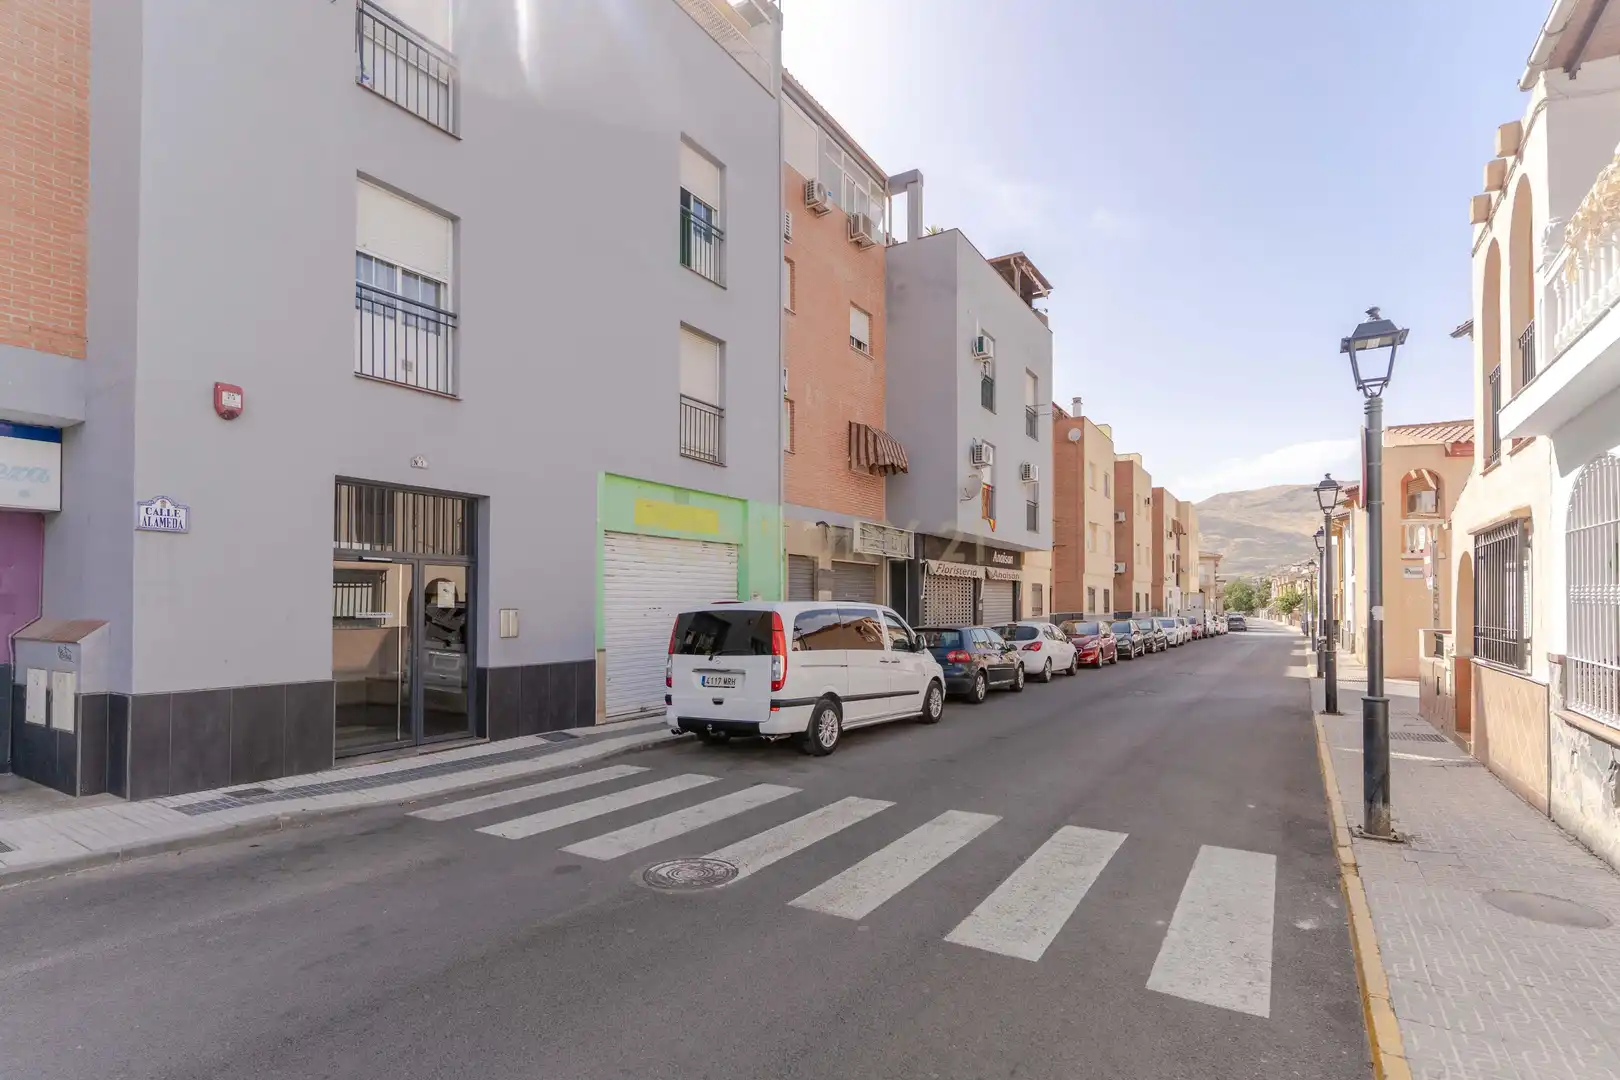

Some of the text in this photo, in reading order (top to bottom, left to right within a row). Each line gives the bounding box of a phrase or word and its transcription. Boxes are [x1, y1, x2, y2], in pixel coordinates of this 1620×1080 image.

[145, 507, 181, 518] CALLE
[142, 516, 183, 530] ALAMEDA
[706, 677, 736, 686] 4117 MRH
